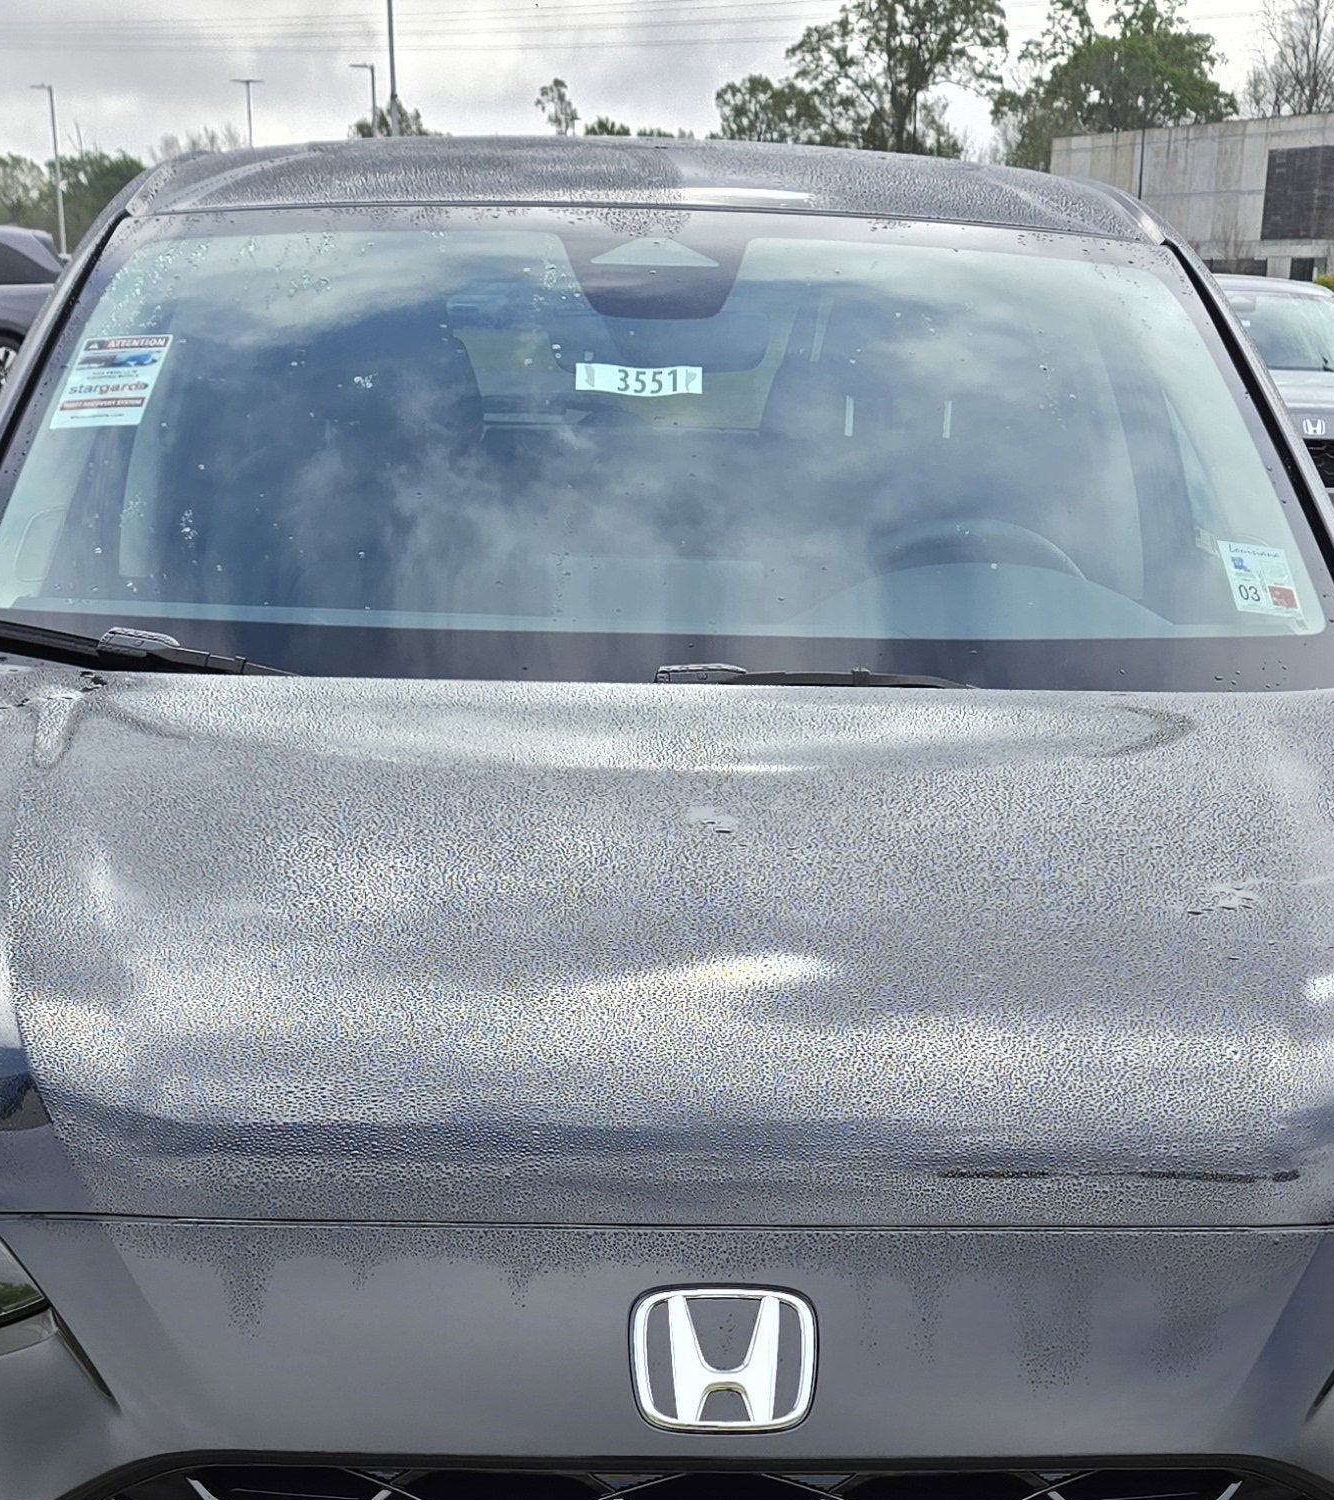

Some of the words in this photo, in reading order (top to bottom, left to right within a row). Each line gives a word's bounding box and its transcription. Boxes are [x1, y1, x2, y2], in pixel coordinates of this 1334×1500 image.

[107, 337, 166, 348] ATTENTION
[617, 368, 678, 394] 3551
[1229, 544, 1280, 558] Louisiana
[1238, 584, 1261, 602] 03
